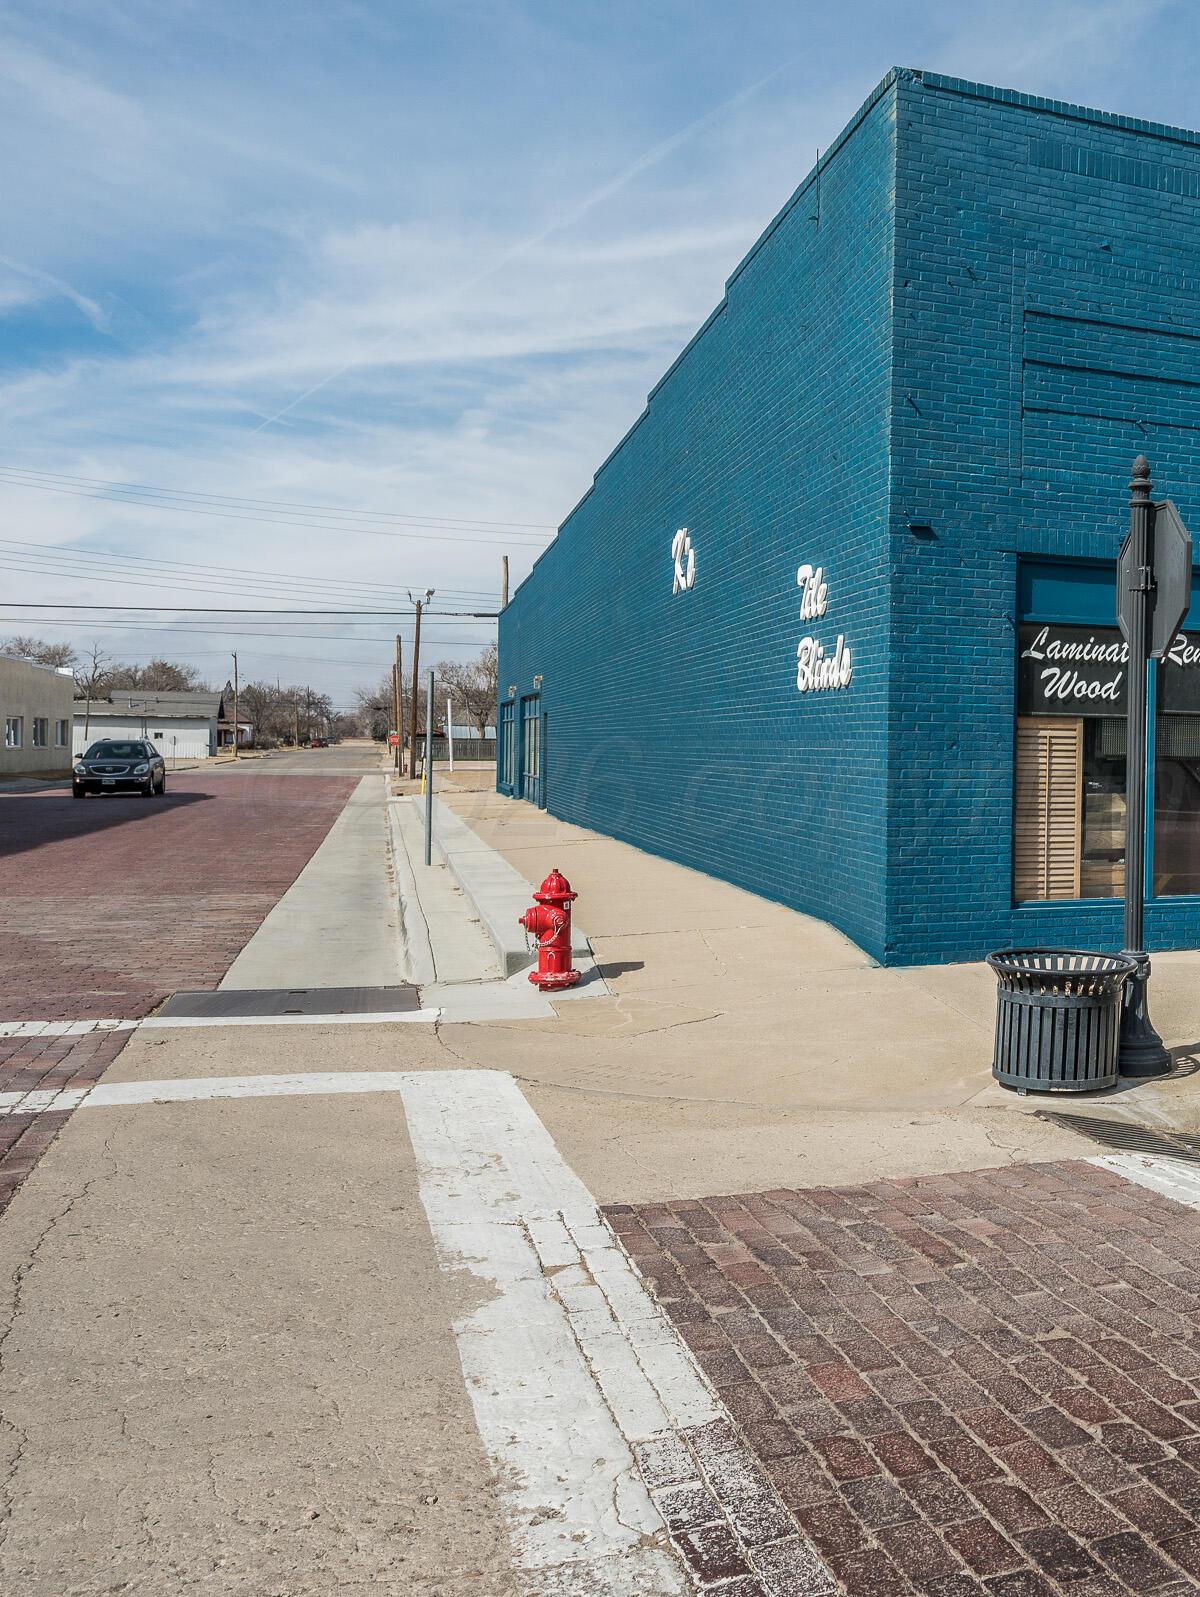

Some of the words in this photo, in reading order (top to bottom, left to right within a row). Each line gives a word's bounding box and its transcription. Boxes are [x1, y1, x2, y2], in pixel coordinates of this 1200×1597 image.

[797, 564, 828, 621] Tile
[797, 634, 852, 692] Blinds
[1021, 626, 1130, 662] Laminat
[1041, 667, 1122, 700] Wood
